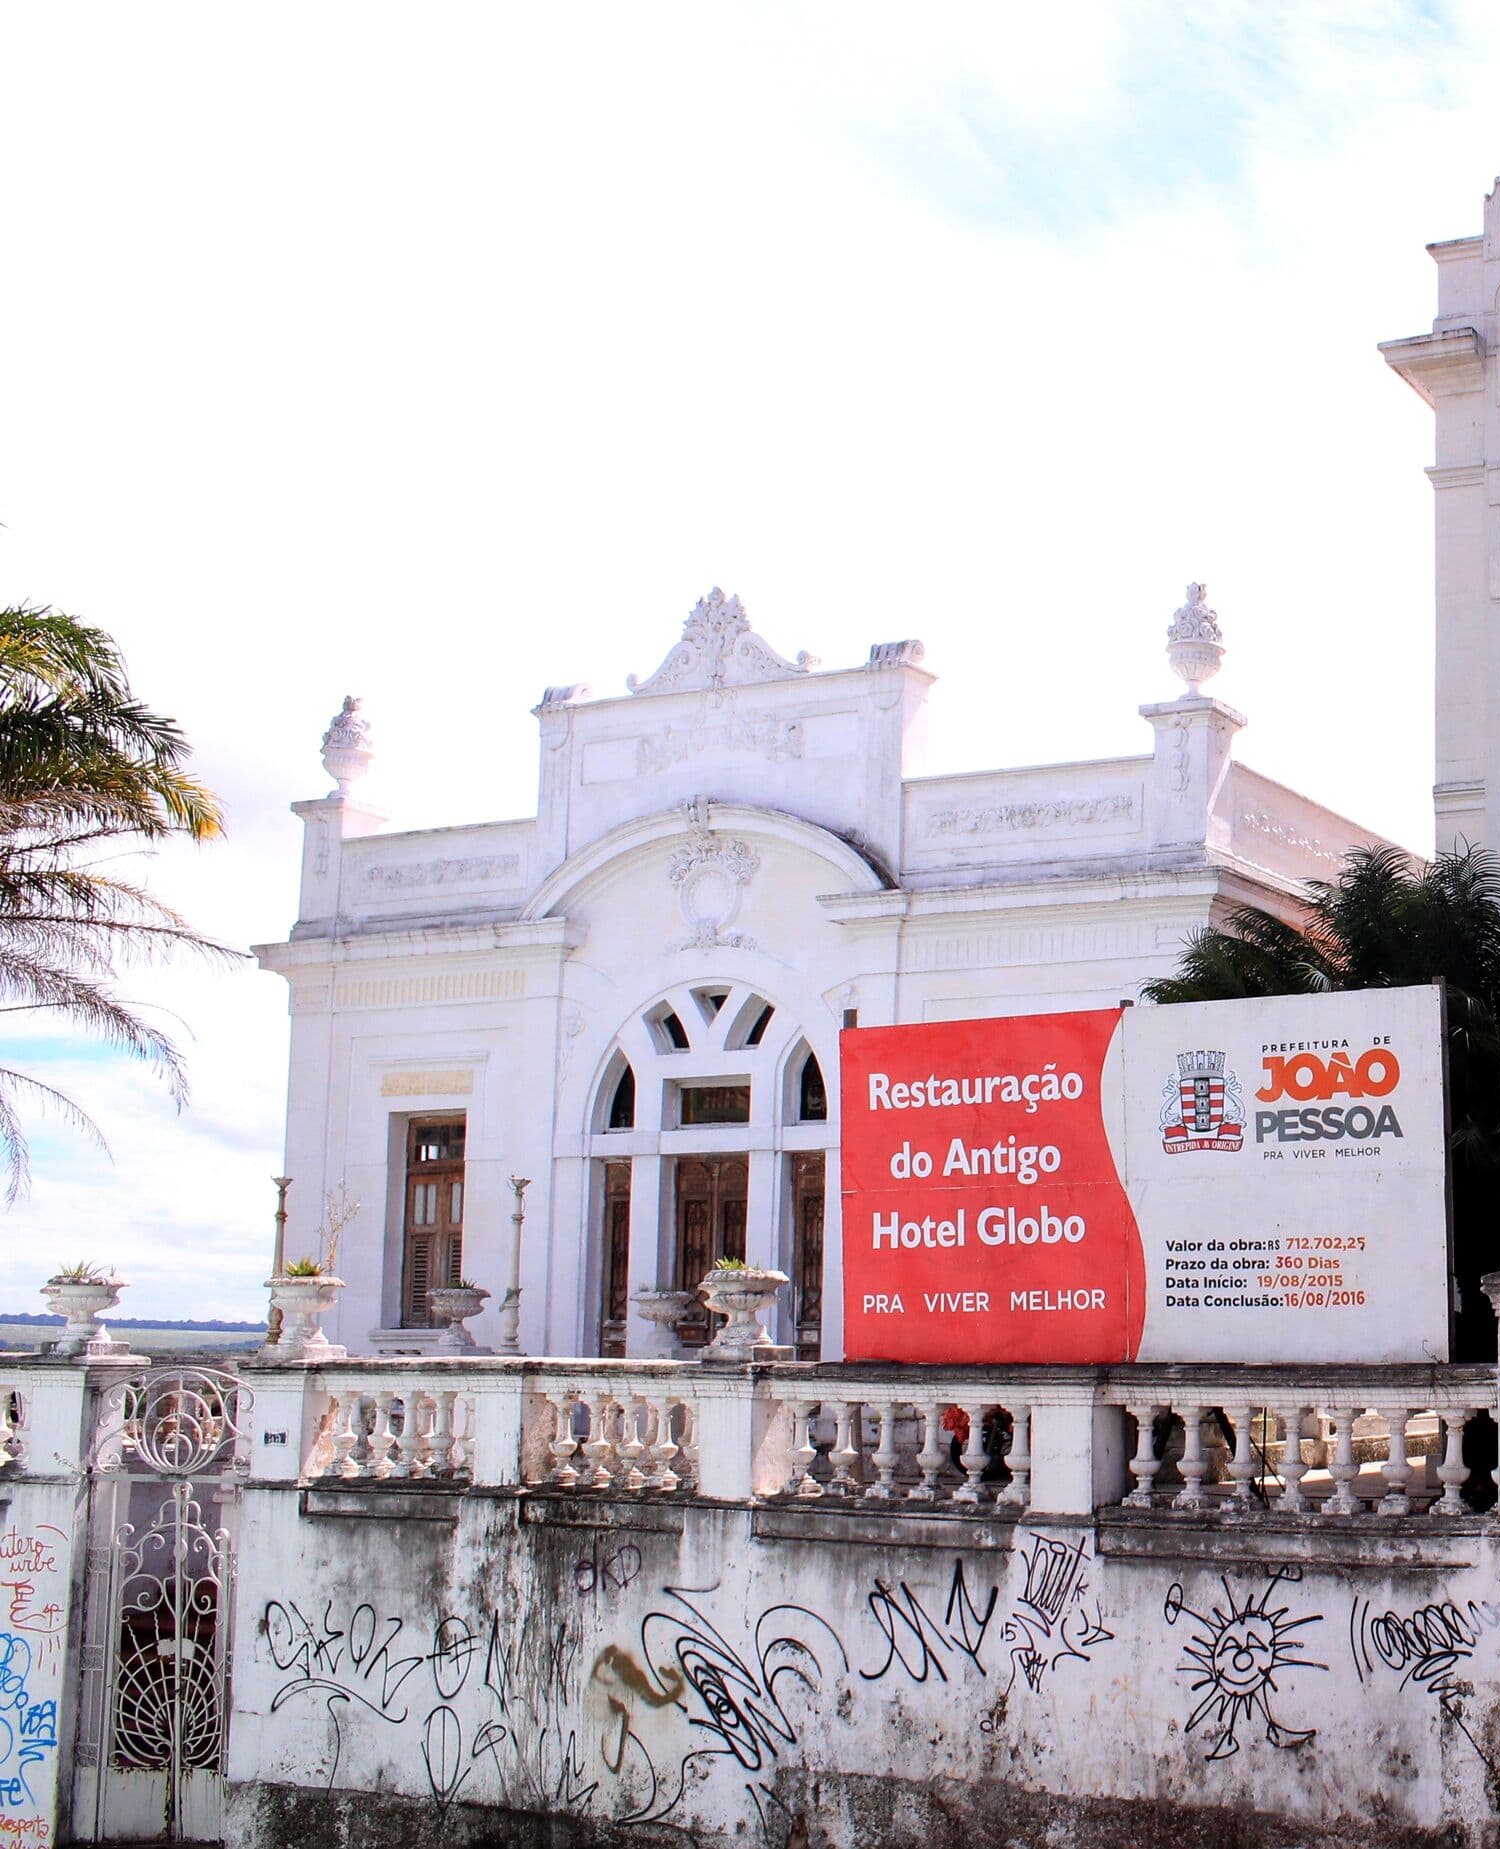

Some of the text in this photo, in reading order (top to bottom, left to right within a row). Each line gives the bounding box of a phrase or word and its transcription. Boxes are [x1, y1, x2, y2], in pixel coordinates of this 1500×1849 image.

[1262, 1036, 1391, 1053] PREFEITURA DE
[1254, 1048, 1400, 1103] JOÃO
[868, 1063, 1083, 1113] Restauração
[1256, 1105, 1404, 1143] PESSOA
[890, 1135, 1061, 1185] do Antigo
[1263, 1147, 1381, 1160] PRA VIVER MELHOR
[872, 1205, 1086, 1249] Hotel Globo
[1166, 1240, 1203, 1252] Valor
[1207, 1240, 1225, 1251] da
[1285, 1237, 1366, 1252] 712.702,25
[1165, 1256, 1340, 1270] Prazo da obra: 360 Dias
[1166, 1274, 1343, 1289] Data Início: 19/08/2015
[863, 1289, 1106, 1314] PRA VIVER MELHOR
[1166, 1295, 1200, 1307] Data
